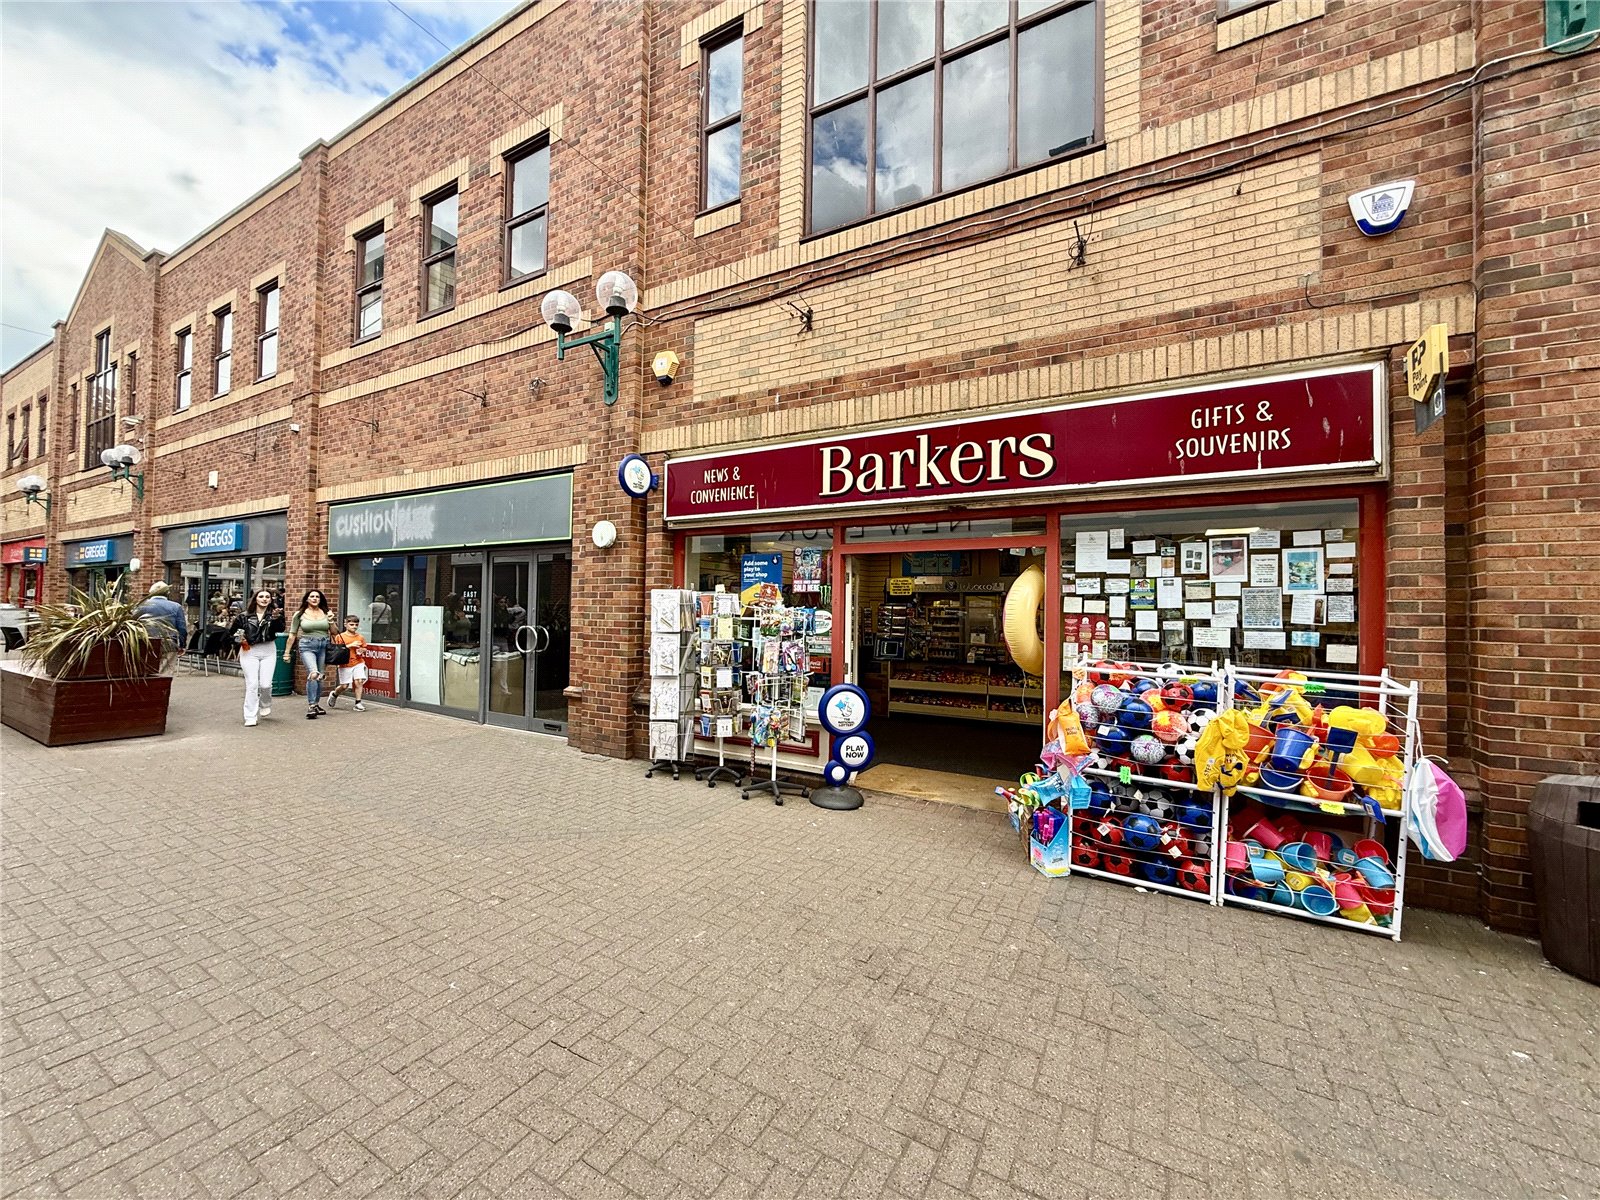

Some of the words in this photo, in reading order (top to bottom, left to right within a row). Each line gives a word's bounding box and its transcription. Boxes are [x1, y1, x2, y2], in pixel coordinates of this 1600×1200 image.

[1412, 374, 1428, 394] Point
[1191, 403, 1245, 429] GIFTS
[1255, 400, 1274, 422] &
[1175, 427, 1291, 460] SOUVENIRS
[819, 432, 1055, 497] Barkers
[704, 467, 729, 484] NEWS
[732, 465, 741, 481] &
[690, 484, 755, 505] CONVENIENCE
[335, 507, 396, 537] CUSHION
[198, 528, 234, 548] GREGGS
[84, 544, 107, 559] GREGGS
[463, 590, 477, 598] EAST
[793, 584, 807, 592] SOLD
[807, 584, 820, 592] HERE
[462, 604, 477, 612] ARTS
[365, 650, 392, 660] ENQUIRIES
[845, 744, 865, 752] PLAY
[845, 751, 865, 759] NOW
